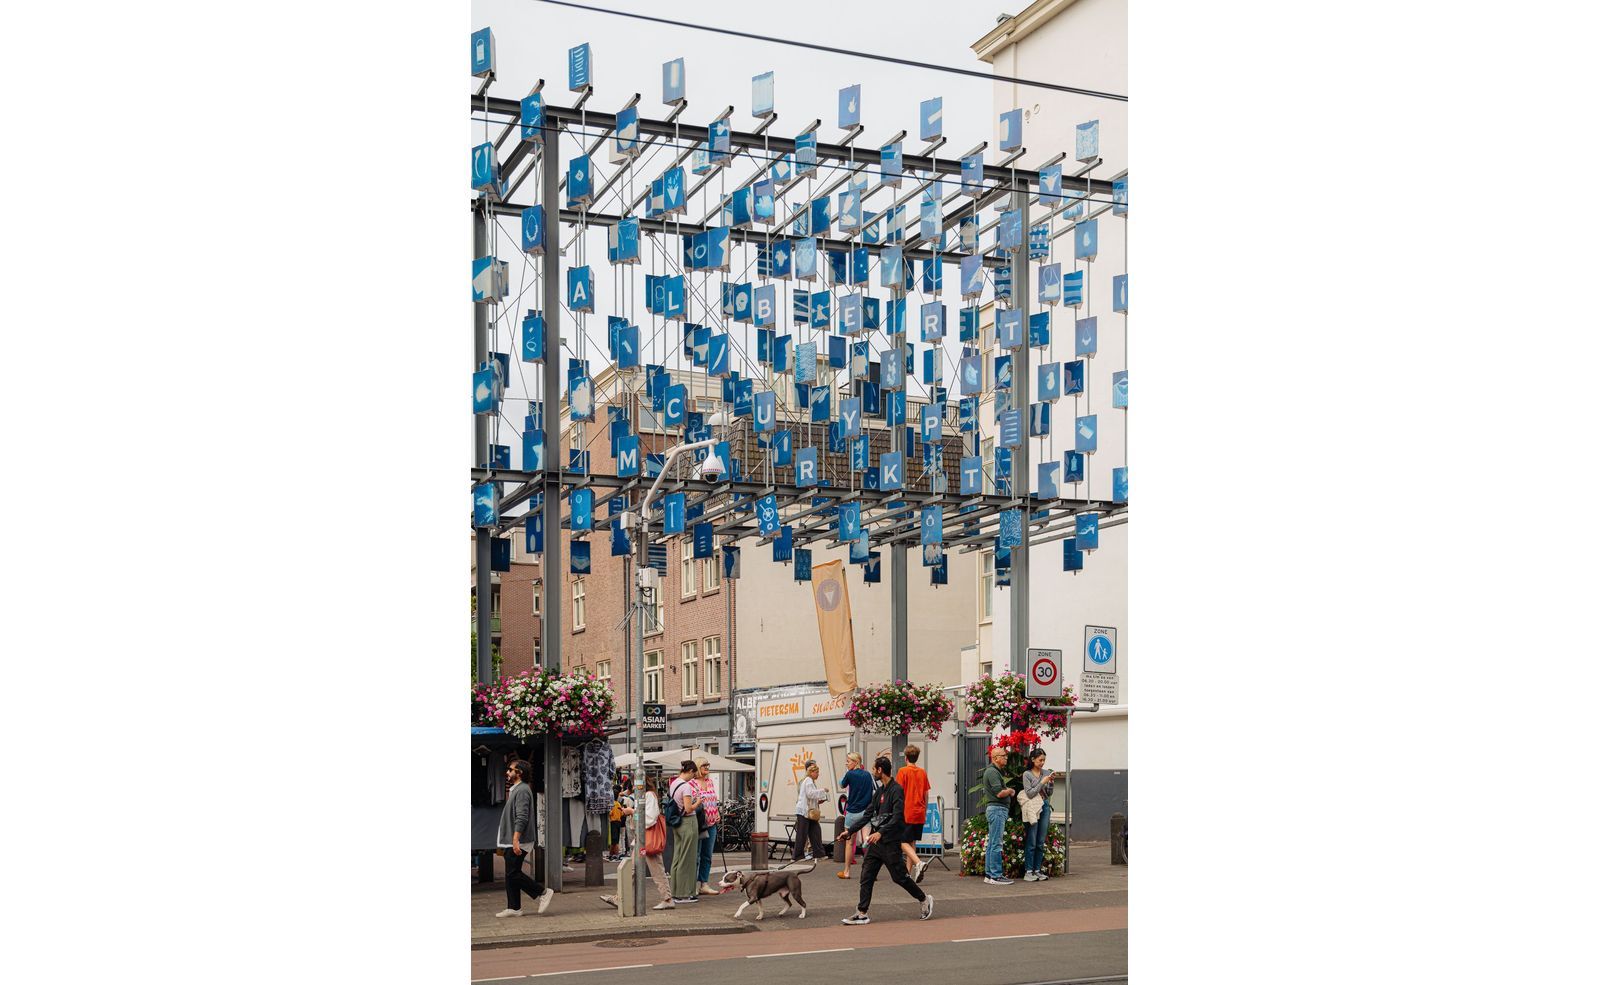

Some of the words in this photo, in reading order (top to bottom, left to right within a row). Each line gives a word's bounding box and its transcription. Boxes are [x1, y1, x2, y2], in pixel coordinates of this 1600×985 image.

[572, 281, 1019, 341] ALBERT
[666, 398, 939, 436] CUYP
[1037, 666, 1052, 678] 30
[760, 702, 799, 717] PIETERSMA
